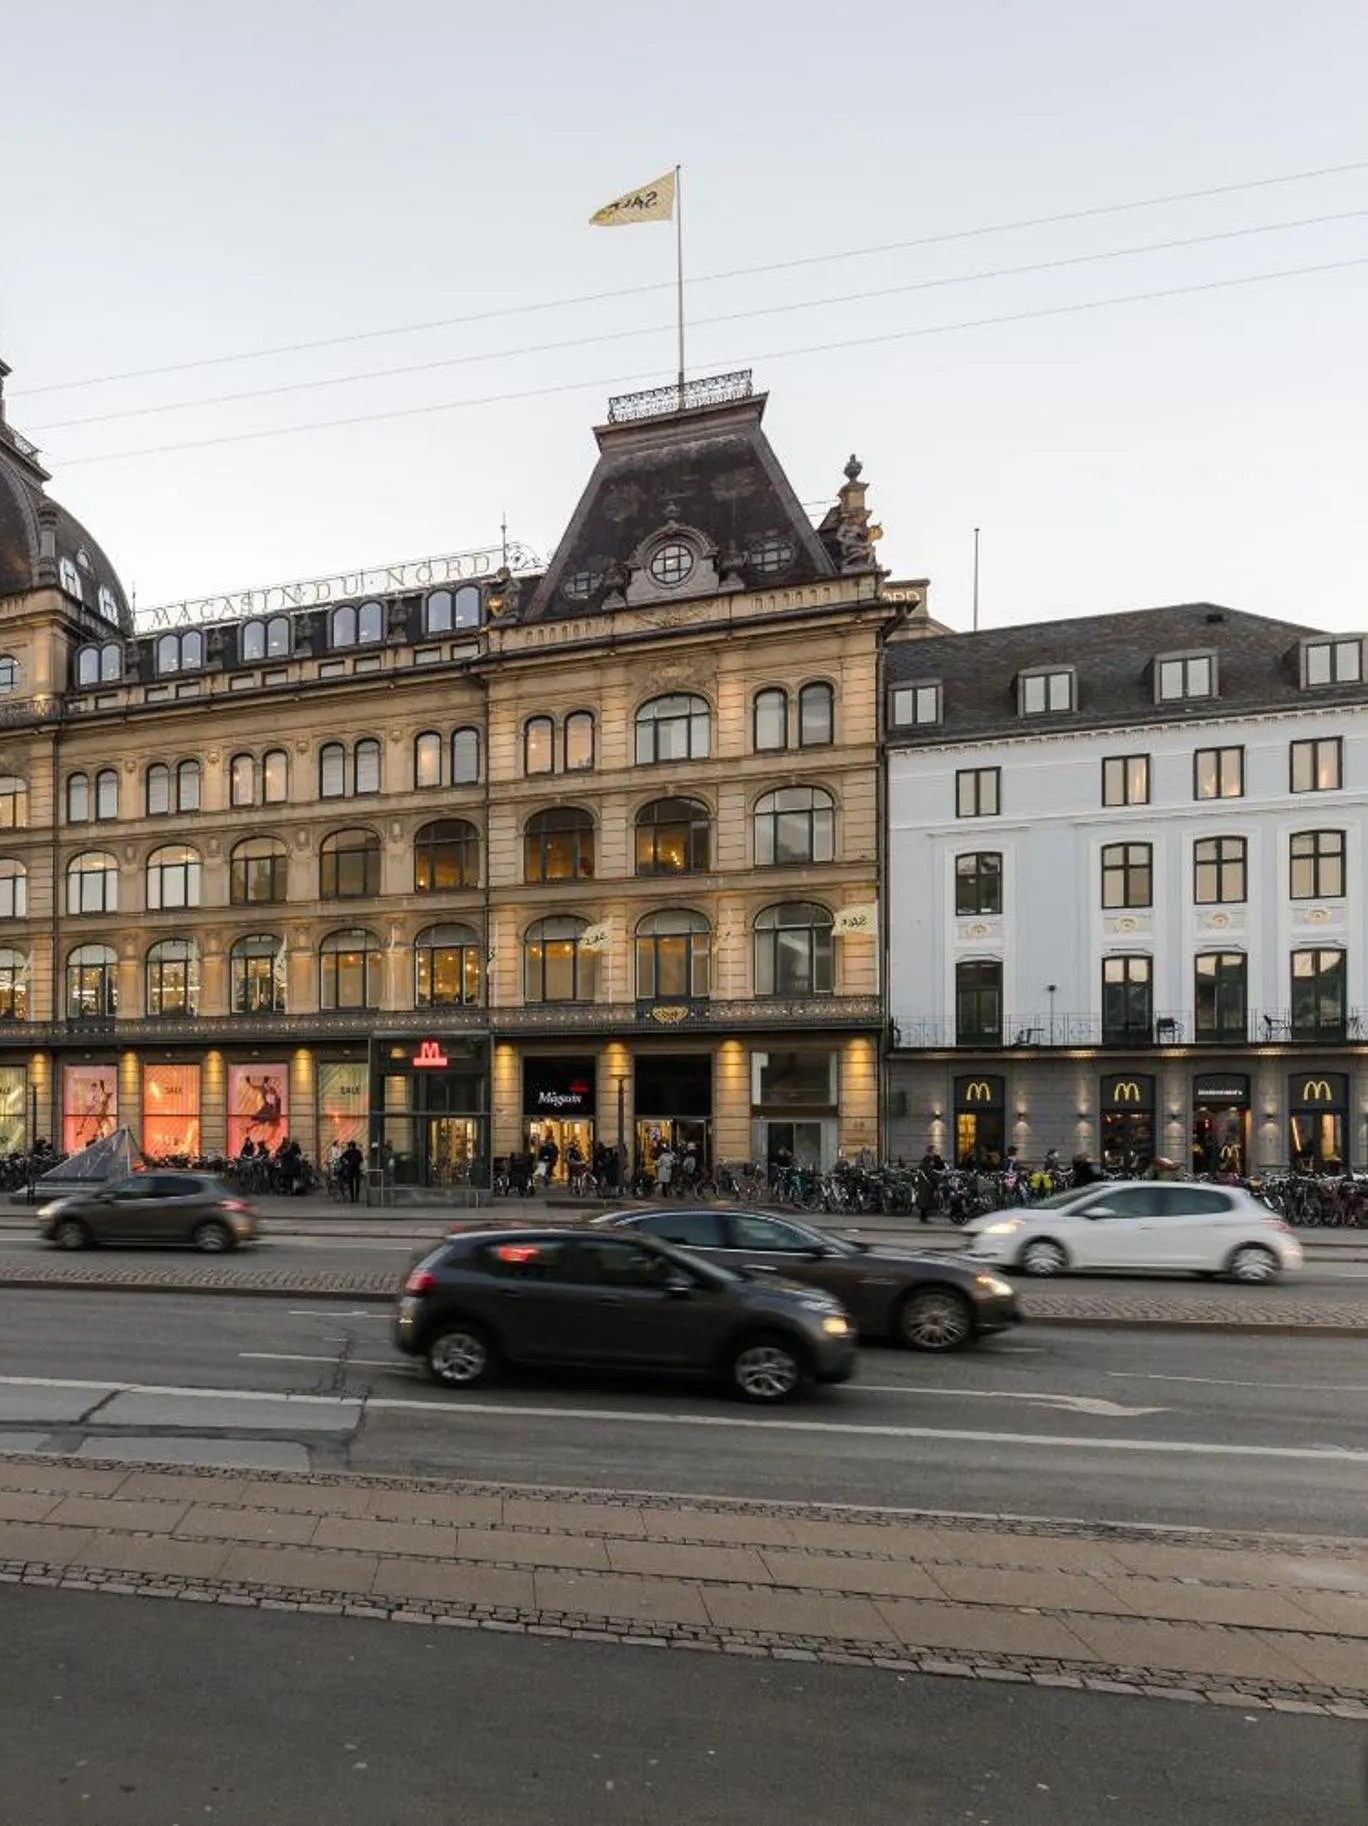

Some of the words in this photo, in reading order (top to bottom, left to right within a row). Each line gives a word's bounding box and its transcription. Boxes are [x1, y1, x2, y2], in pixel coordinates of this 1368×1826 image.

[149, 583, 303, 627] MAGASIN
[315, 574, 361, 601] DU
[385, 554, 490, 592] NORD
